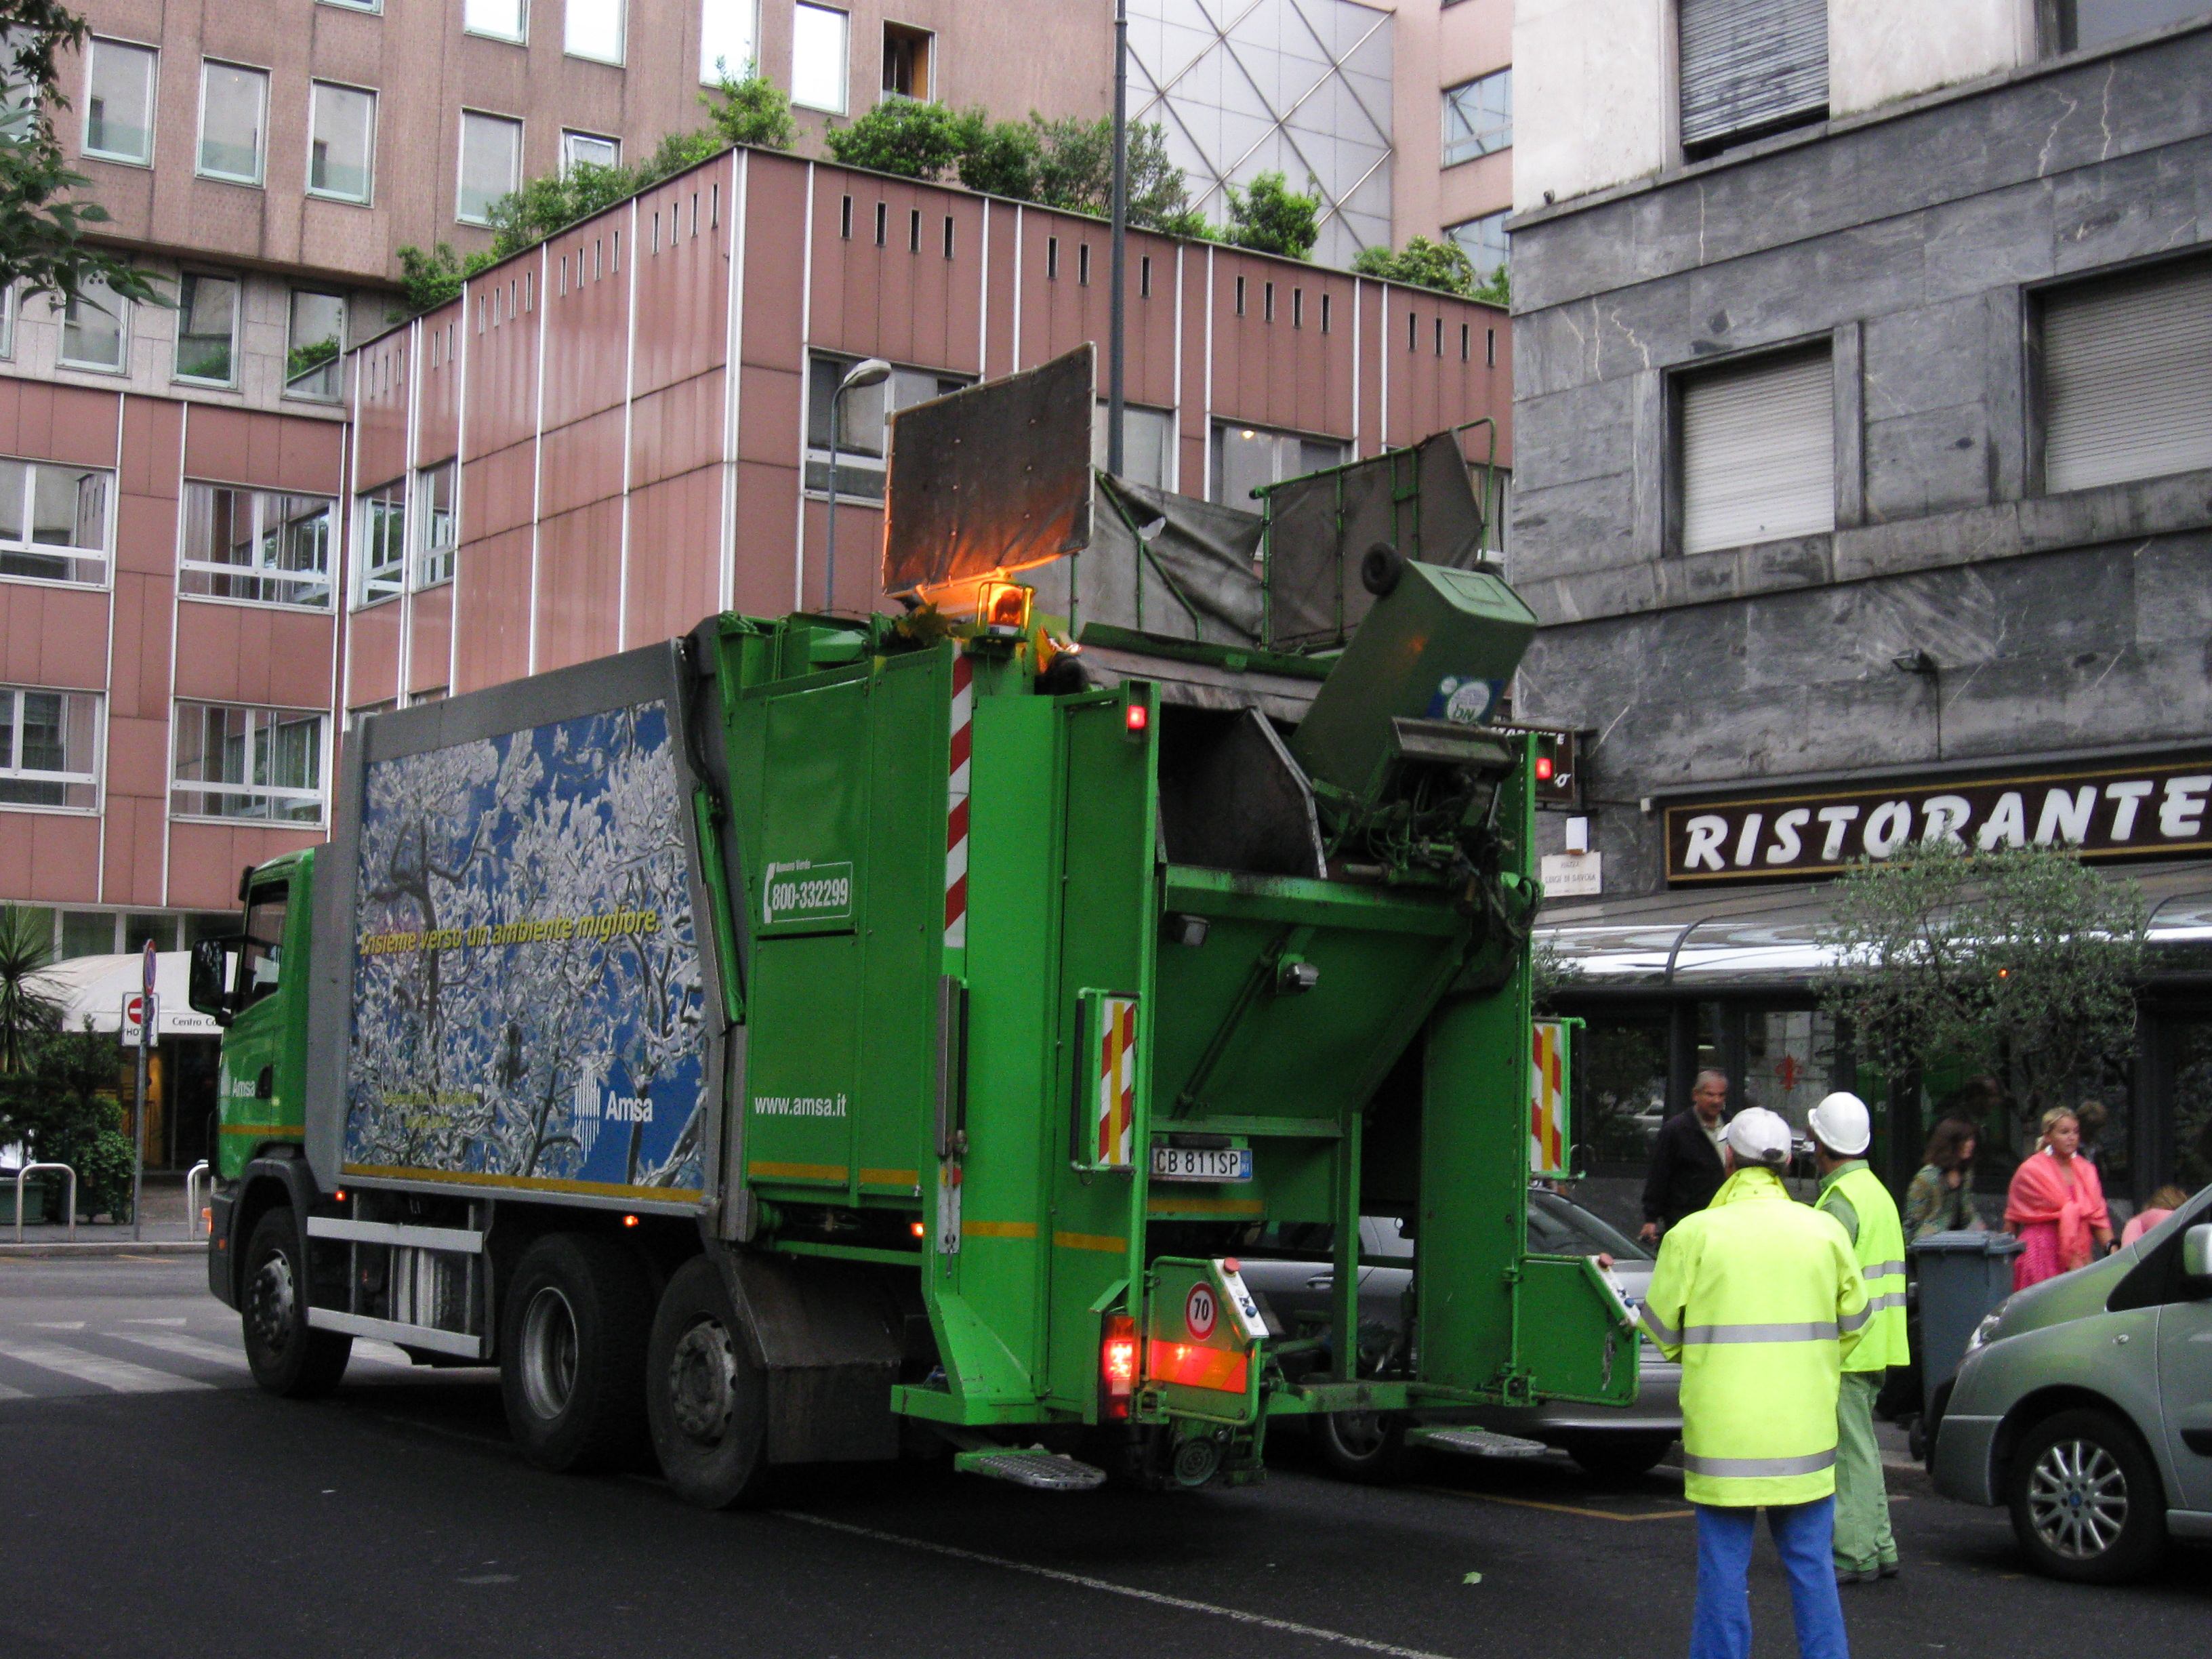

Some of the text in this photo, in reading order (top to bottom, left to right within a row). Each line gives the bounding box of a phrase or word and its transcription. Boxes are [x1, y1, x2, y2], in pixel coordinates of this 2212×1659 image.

[1683, 775, 2212, 872] RISTORANTE
[772, 877, 848, 911] 800-332299
[360, 904, 662, 956] Insieme verso un ambiente migliore.
[172, 1017, 202, 1027] Centro
[232, 1078, 256, 1098] Amsa
[605, 1090, 653, 1122] Amsa
[754, 1092, 847, 1117] www.amsa.it
[1194, 1297, 1210, 1322] 70
